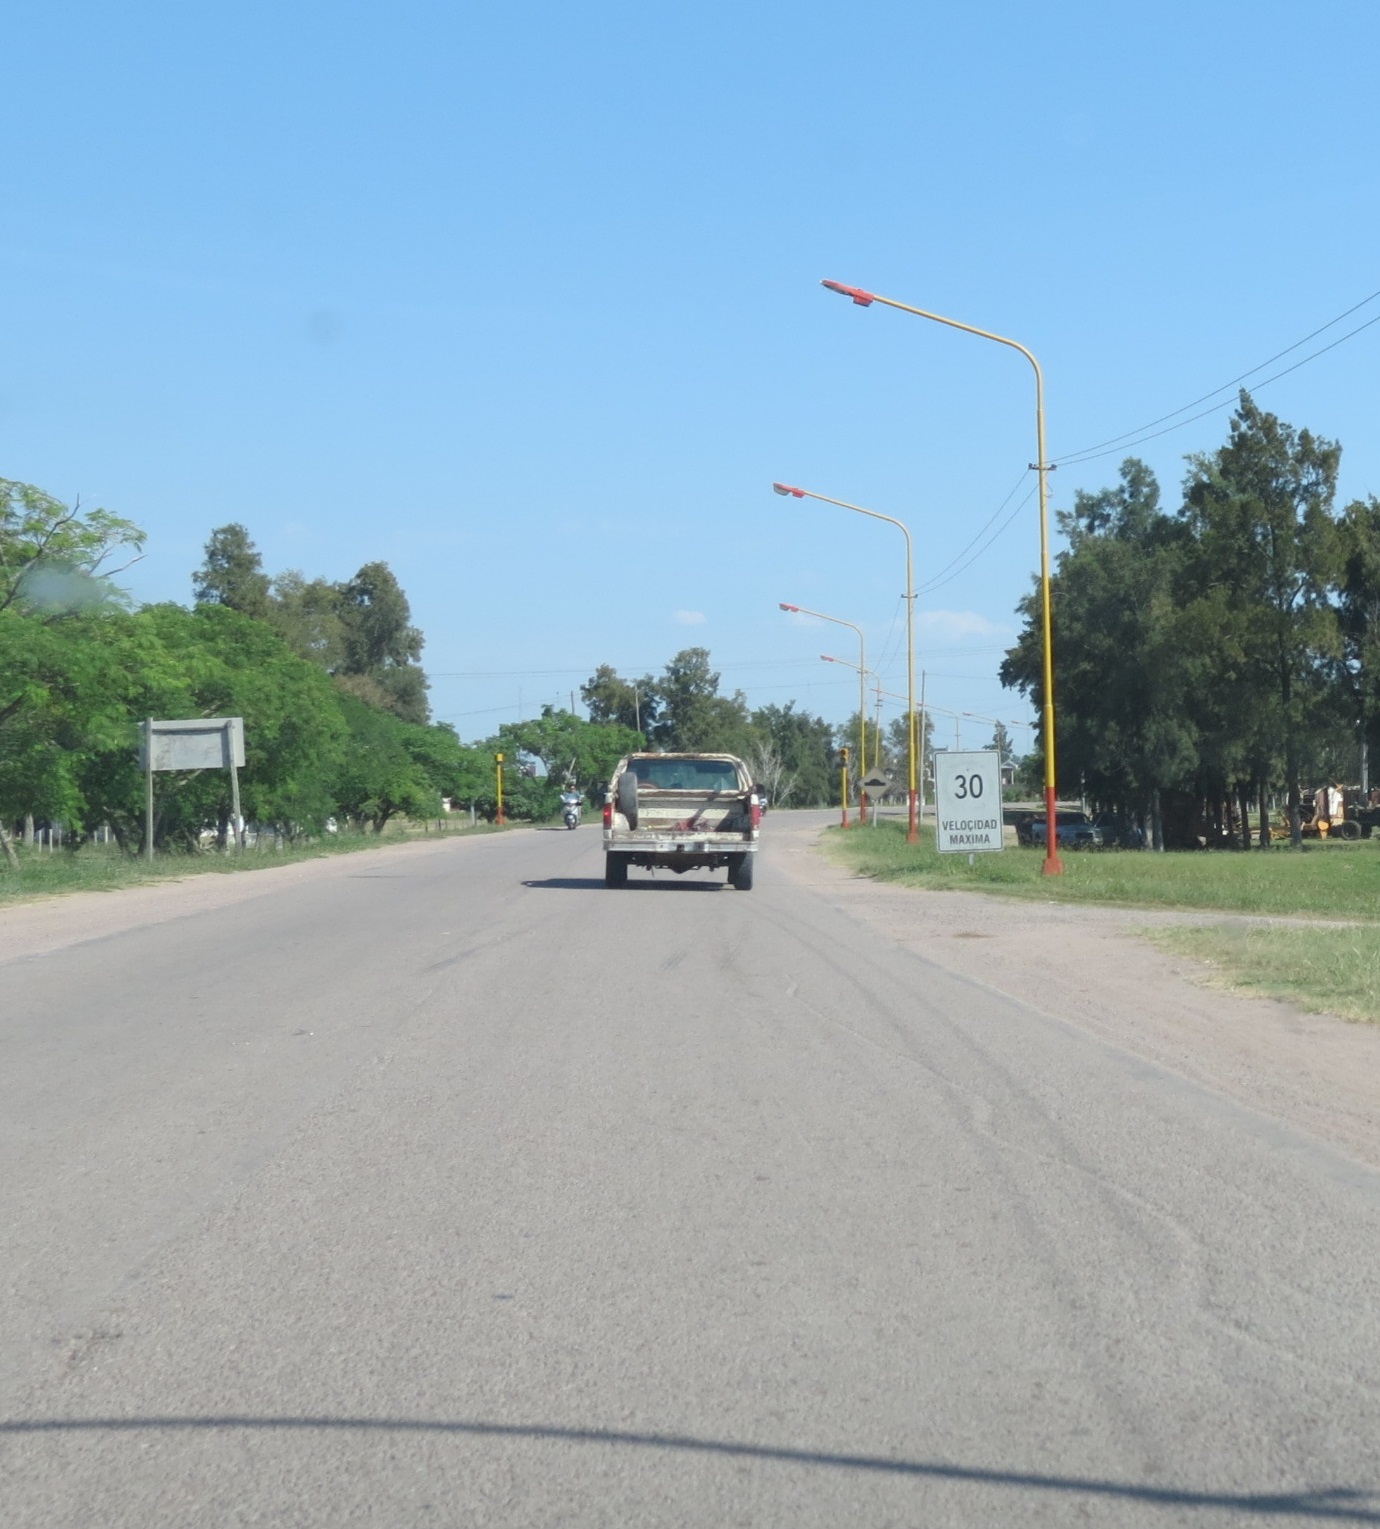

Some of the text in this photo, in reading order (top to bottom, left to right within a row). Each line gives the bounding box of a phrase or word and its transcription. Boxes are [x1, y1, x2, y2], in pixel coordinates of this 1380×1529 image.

[954, 774, 983, 799] 30
[942, 819, 997, 831] VELOCIDAD
[949, 833, 990, 845] MAXIMA
